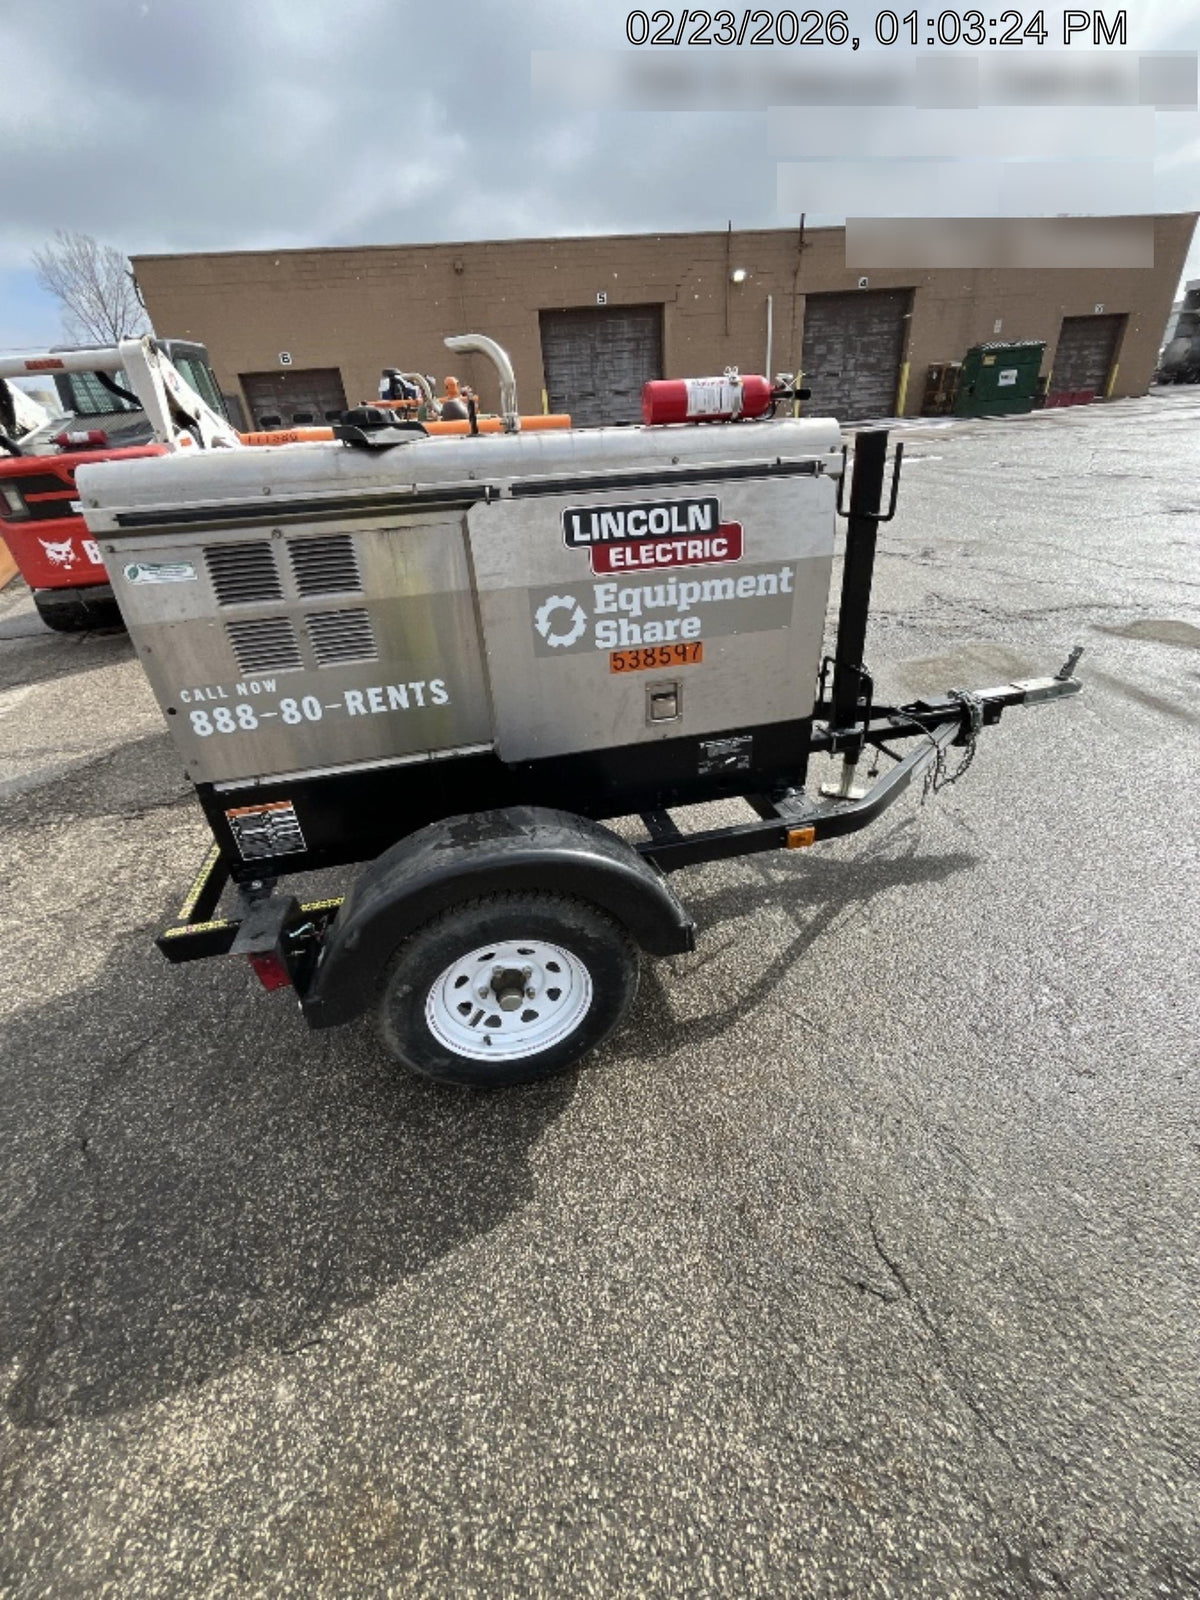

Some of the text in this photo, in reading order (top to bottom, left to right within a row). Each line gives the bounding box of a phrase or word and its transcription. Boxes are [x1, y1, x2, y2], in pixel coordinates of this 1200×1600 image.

[571, 503, 712, 542] LINCOLN
[609, 538, 728, 568] ELECTRIC
[593, 566, 794, 617] Equipment
[594, 616, 702, 649] Share
[612, 642, 703, 671] 538597
[180, 679, 277, 703] CALL NOW
[189, 678, 449, 737] 888-80-RENTS
